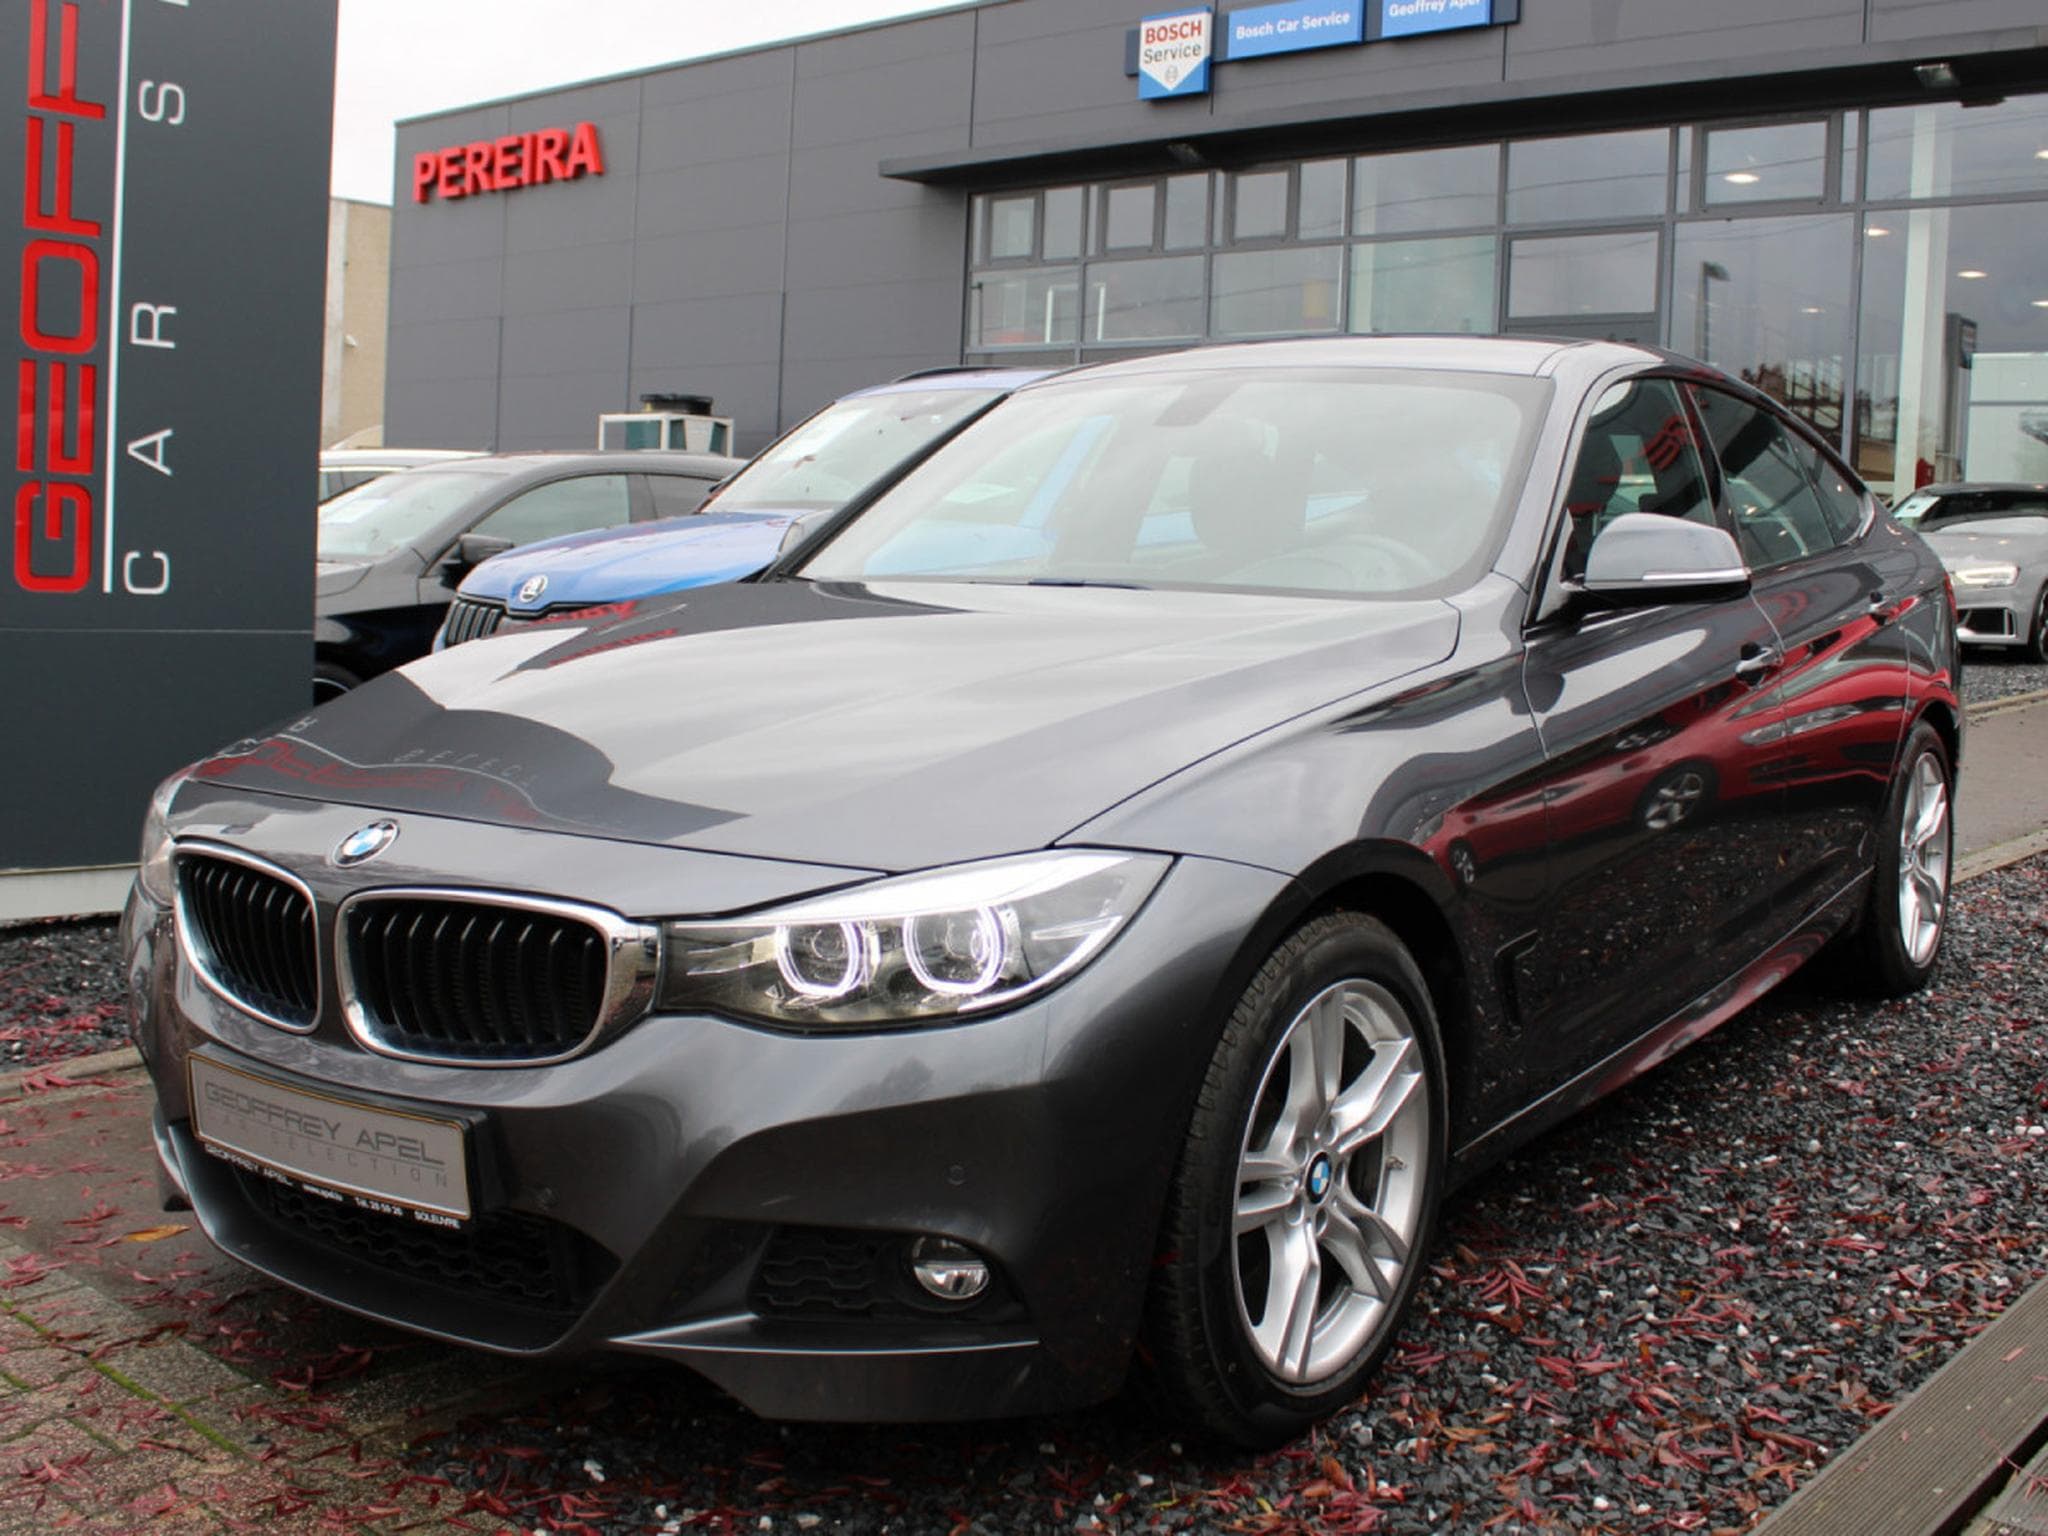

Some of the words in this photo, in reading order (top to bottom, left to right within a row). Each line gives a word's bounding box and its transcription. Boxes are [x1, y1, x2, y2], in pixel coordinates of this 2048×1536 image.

[1145, 20, 1202, 44] BOSCH
[1236, 22, 1273, 39] Bosch
[1276, 17, 1298, 32] Car
[1302, 11, 1350, 30] Service
[1144, 41, 1201, 64] Service
[413, 121, 604, 204] PEREIRA
[205, 1081, 342, 1141] GEOFFREY
[355, 1129, 446, 1166] APEL
[272, 1131, 448, 1188] SELECTION
